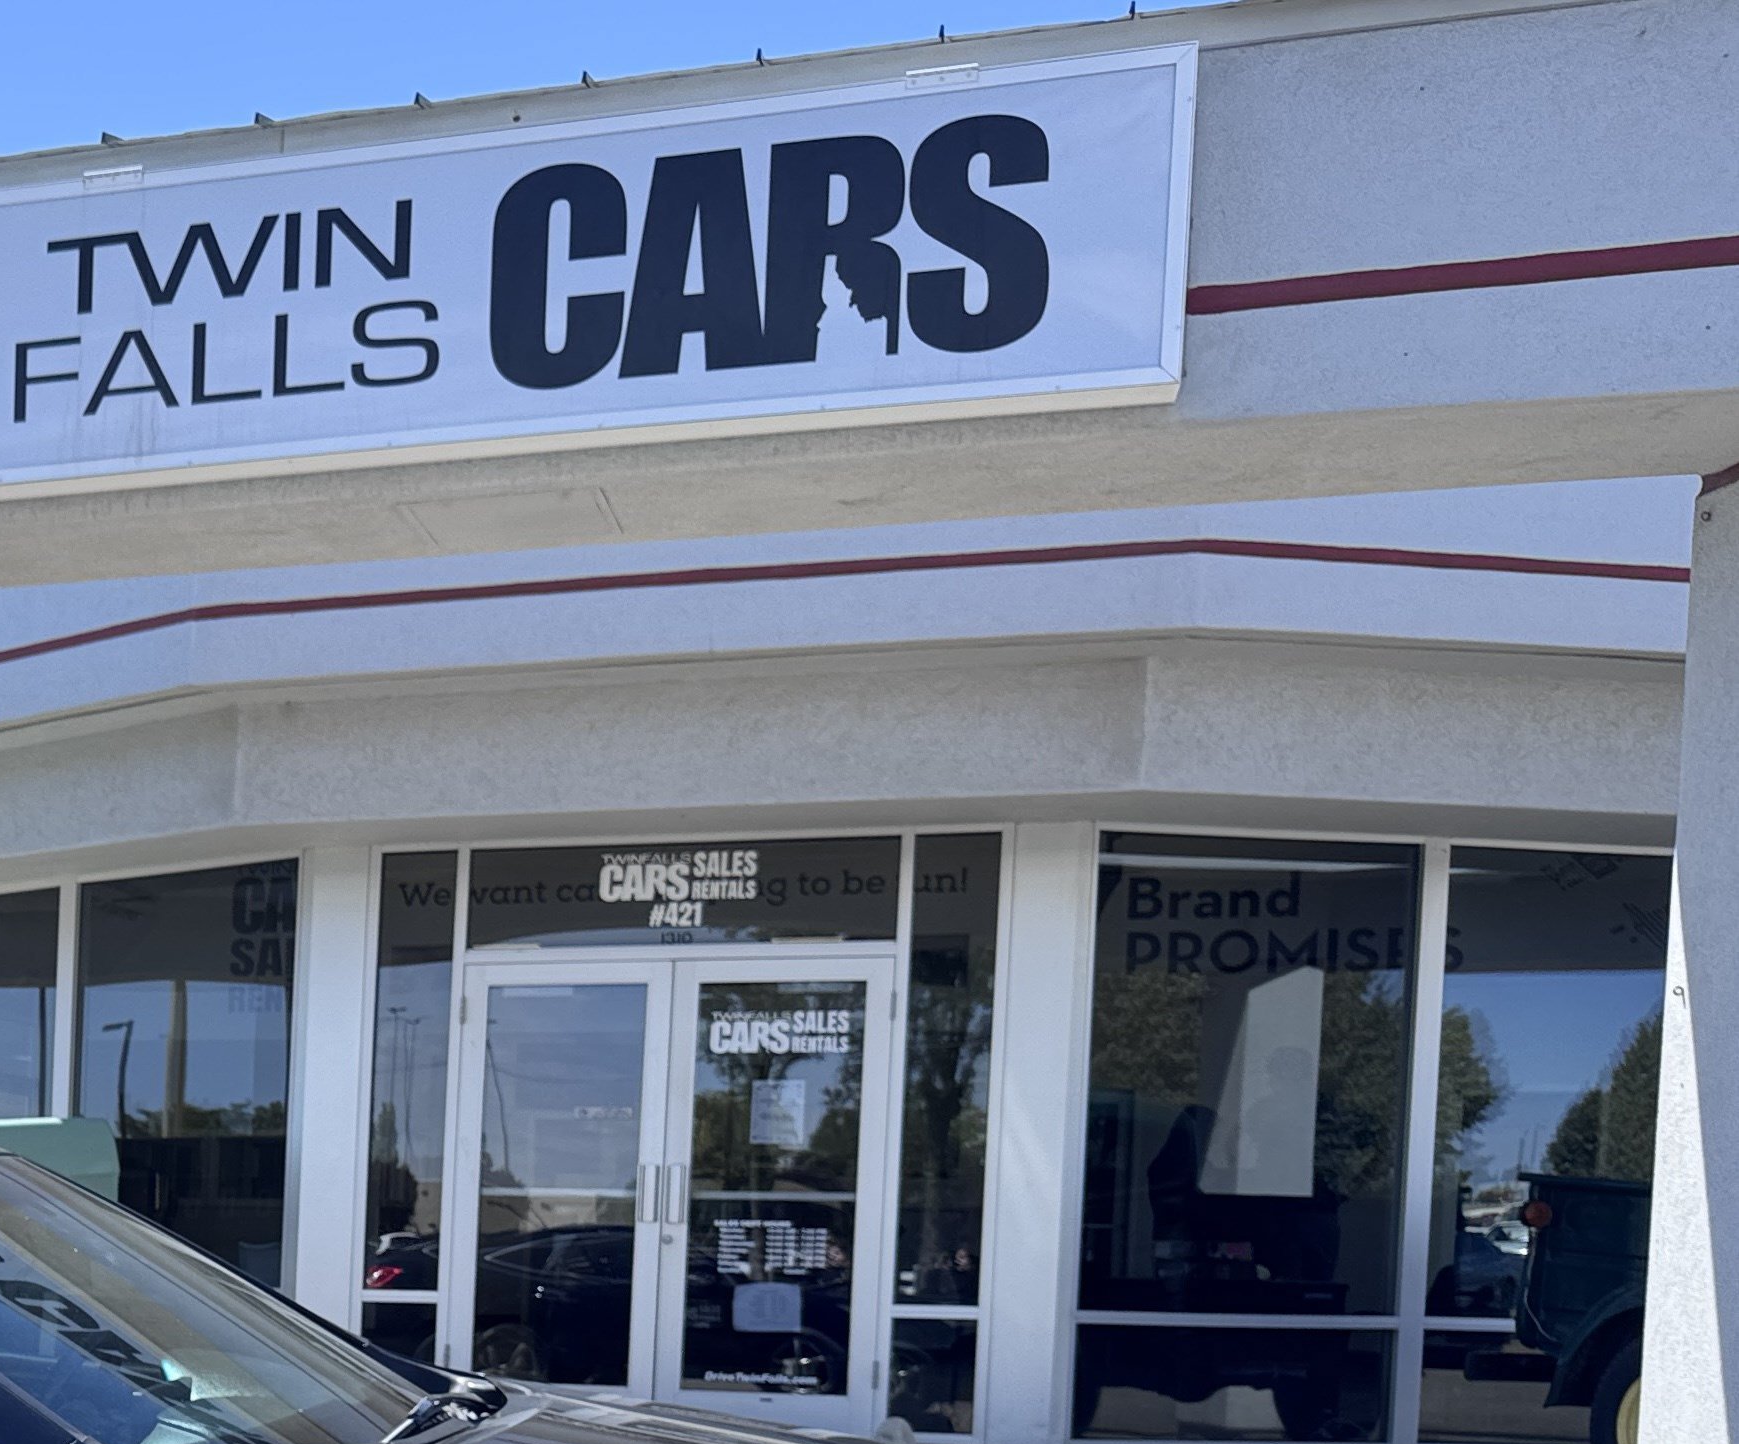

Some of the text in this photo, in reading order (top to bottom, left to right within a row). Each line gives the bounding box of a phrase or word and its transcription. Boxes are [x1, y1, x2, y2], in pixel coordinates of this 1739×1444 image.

[47, 198, 412, 315] TWIN
[490, 114, 1050, 390] CARS
[13, 300, 440, 424] FALLS
[693, 851, 757, 877] SALES
[398, 881, 451, 908] We
[599, 863, 690, 902] CARS
[691, 880, 757, 900] RENTALS
[797, 871, 832, 896] to
[841, 868, 886, 896] be
[1125, 870, 1301, 922] Brand
[648, 901, 704, 928] #421
[792, 1009, 850, 1034] SALES
[709, 1019, 791, 1054] CARS
[791, 1035, 850, 1054] RENTALS
